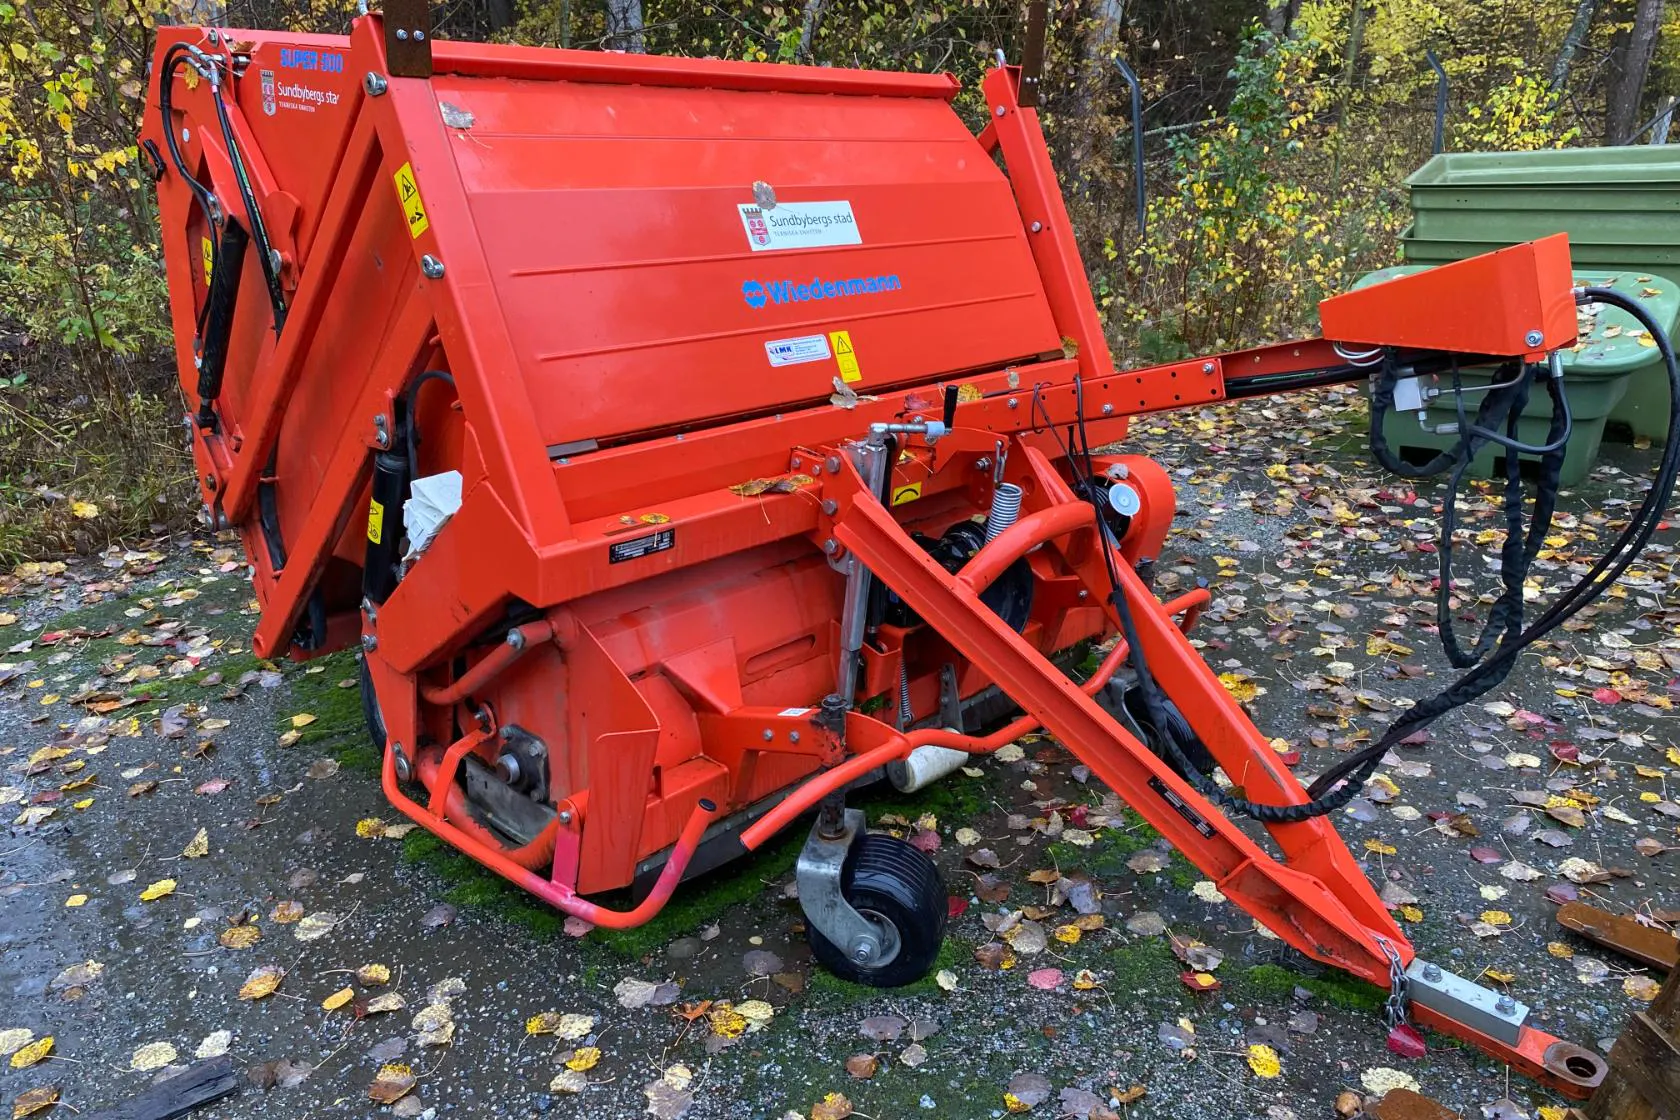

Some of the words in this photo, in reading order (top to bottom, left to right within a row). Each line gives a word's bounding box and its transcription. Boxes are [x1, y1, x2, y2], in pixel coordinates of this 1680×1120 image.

[281, 48, 318, 70] SUPER
[277, 82, 325, 105] Sundbybergs
[769, 213, 833, 228] Sundbybergs
[833, 212, 853, 224] stad
[765, 274, 902, 305] Wiedenmann
